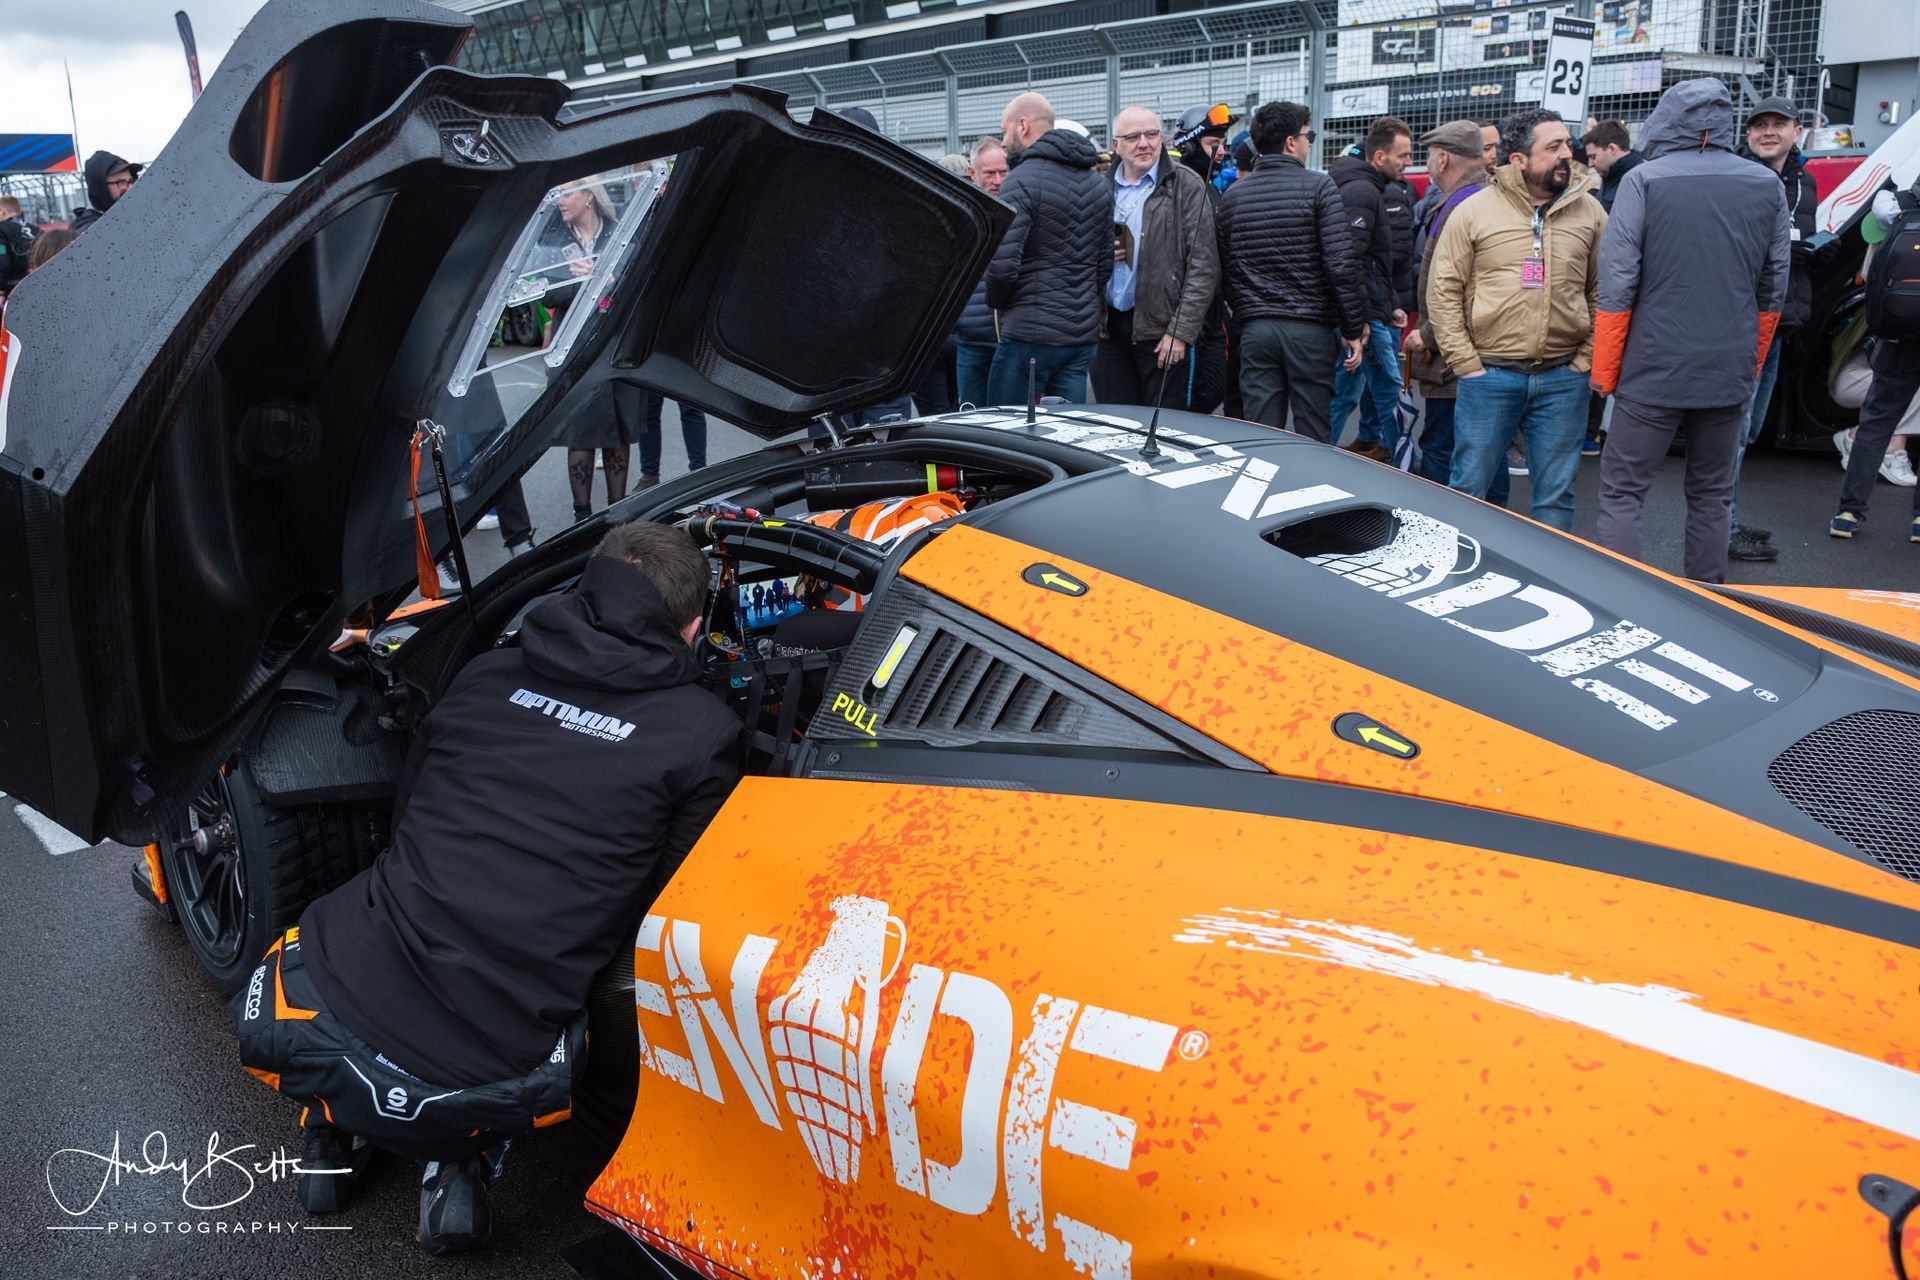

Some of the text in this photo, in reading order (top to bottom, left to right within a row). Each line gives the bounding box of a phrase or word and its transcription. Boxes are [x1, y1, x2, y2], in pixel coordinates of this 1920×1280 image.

[1551, 59, 1584, 96] 23
[509, 688, 637, 739] OPTIMUM
[559, 720, 624, 743] MOTORSPORT
[831, 691, 878, 737] PULL
[244, 965, 267, 1020] sparco
